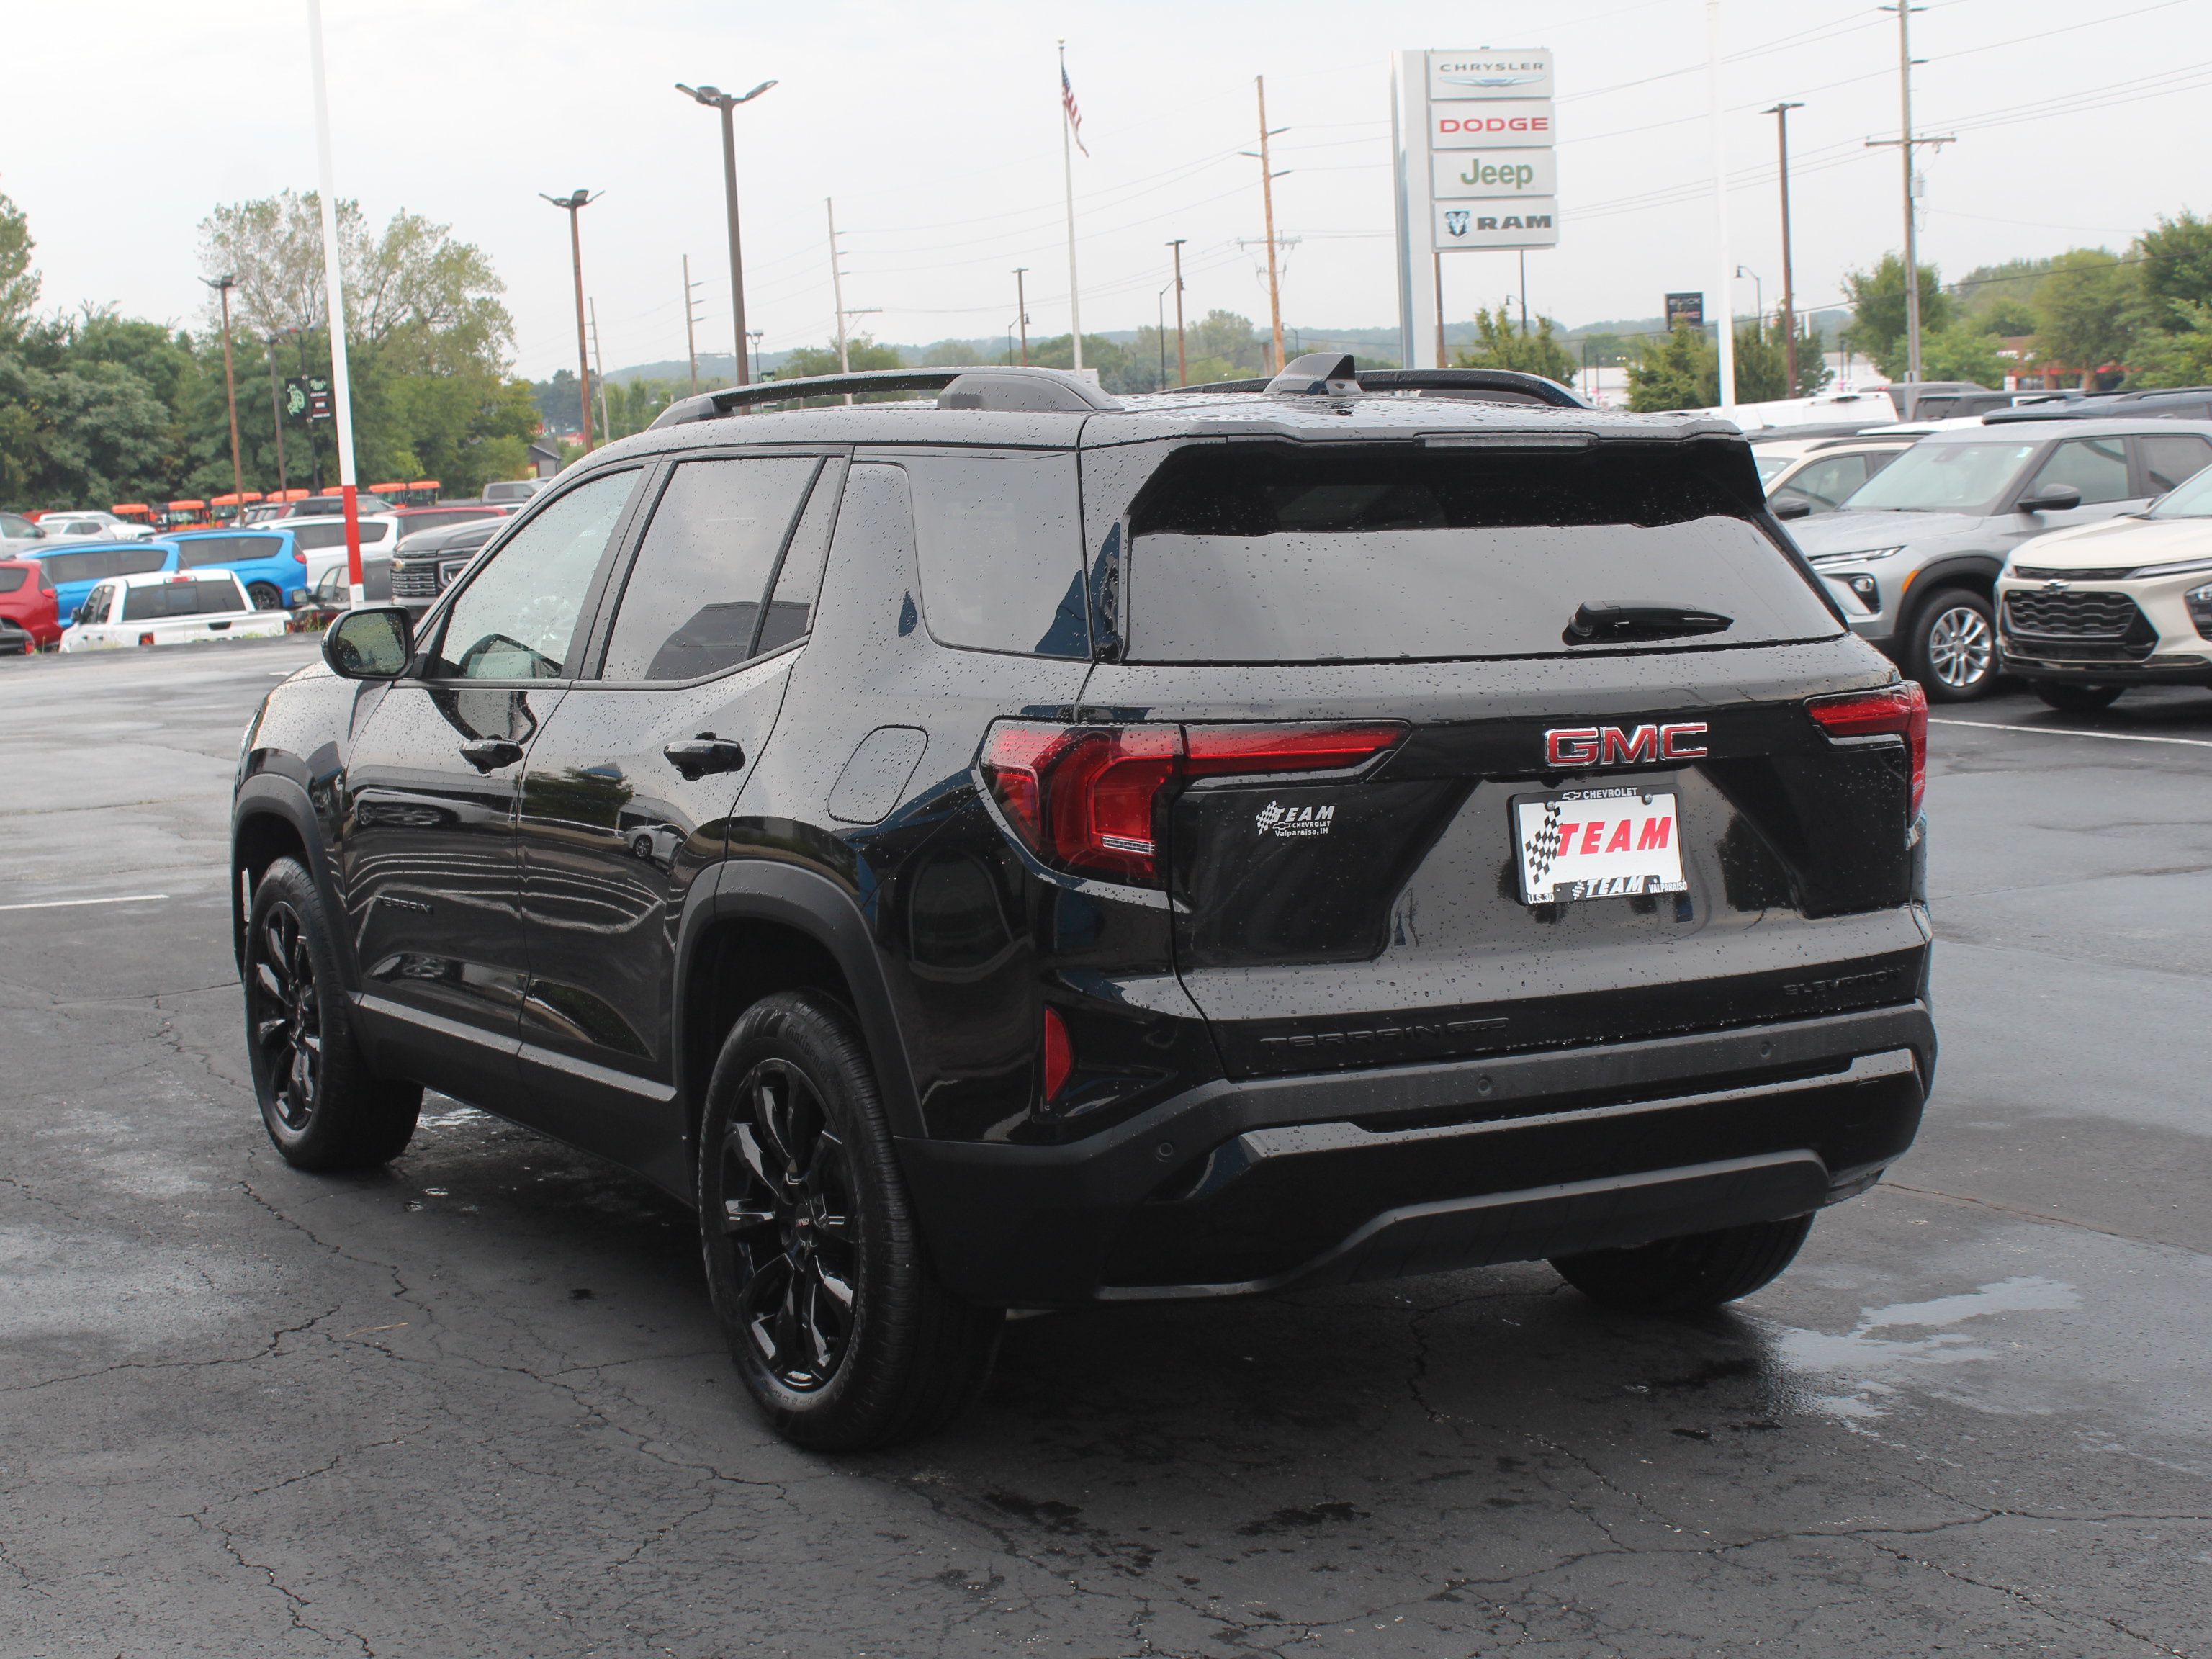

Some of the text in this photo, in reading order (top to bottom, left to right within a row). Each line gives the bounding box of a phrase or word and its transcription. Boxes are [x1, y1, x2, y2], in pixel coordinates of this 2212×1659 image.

[1439, 62, 1545, 72] CHRYSLER
[1439, 117, 1549, 132] DODGE
[1460, 158, 1533, 189] Jeep
[1477, 215, 1552, 230] RAM
[1544, 722, 1708, 768] GMC
[1583, 787, 1638, 800] CHEVROLET
[1274, 805, 1335, 822] TEAM
[1275, 828, 1319, 837] Valparaiso,
[1556, 817, 1672, 857] TEAM
[1586, 875, 1645, 896] TEAM
[1648, 881, 1688, 894] VALPARAISO
[1259, 1023, 1441, 1050] TERRAIN
[786, 1023, 830, 1084] Continental
